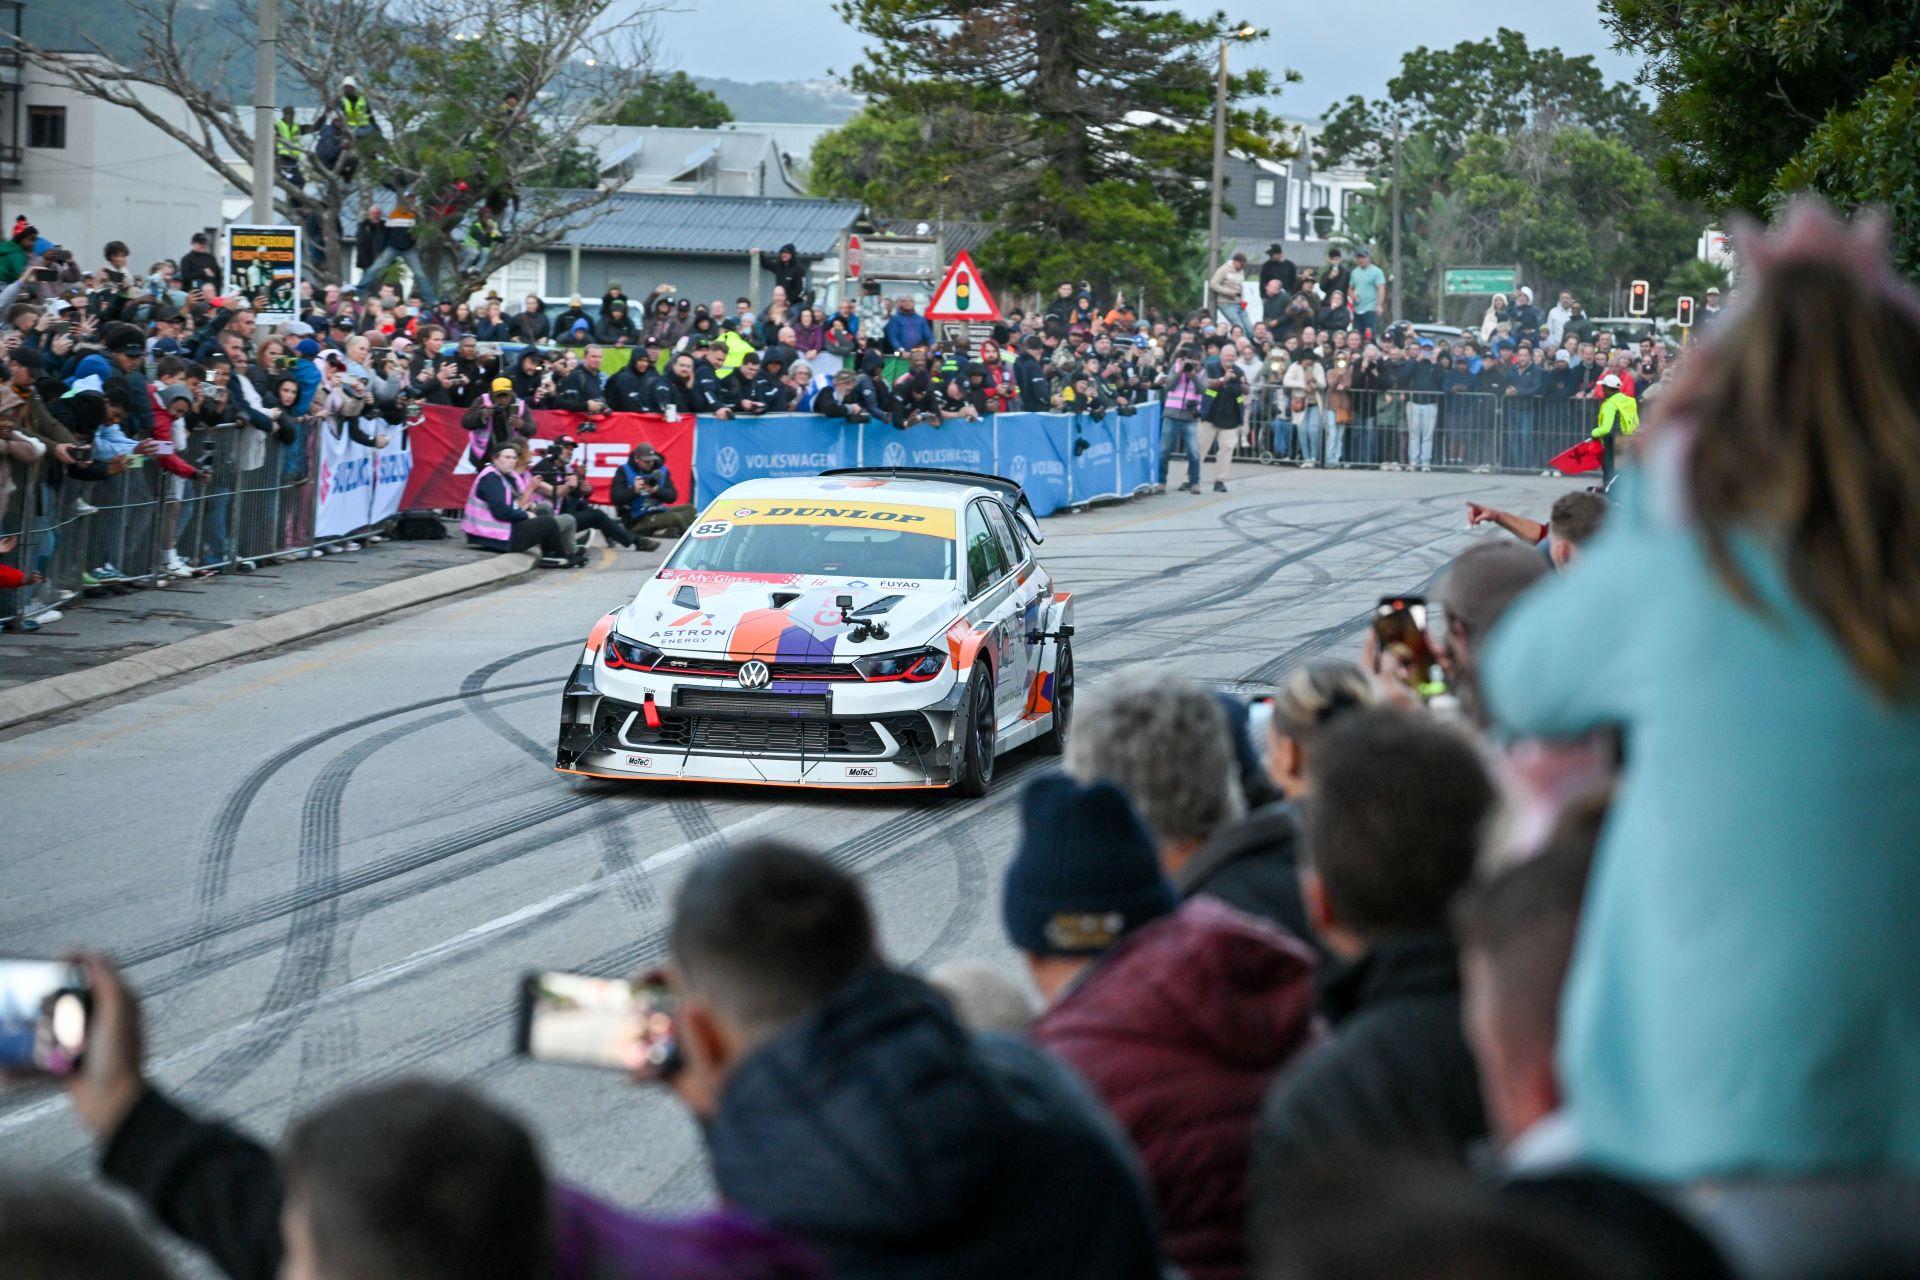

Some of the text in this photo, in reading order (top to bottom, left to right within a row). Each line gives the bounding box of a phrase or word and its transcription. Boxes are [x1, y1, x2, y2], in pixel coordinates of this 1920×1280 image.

[744, 453, 837, 469] VOLKSWAGEN
[912, 449, 980, 464] VOLKSWAGEN
[332, 457, 370, 494] SUZUK
[763, 507, 926, 523] DUNLOP
[696, 523, 728, 535] 85
[880, 580, 920, 589] FUYAO
[649, 629, 726, 639] ASTRON
[660, 637, 708, 645] ENERGY
[628, 757, 650, 767] MoTeC
[848, 768, 874, 776] MoTeC
